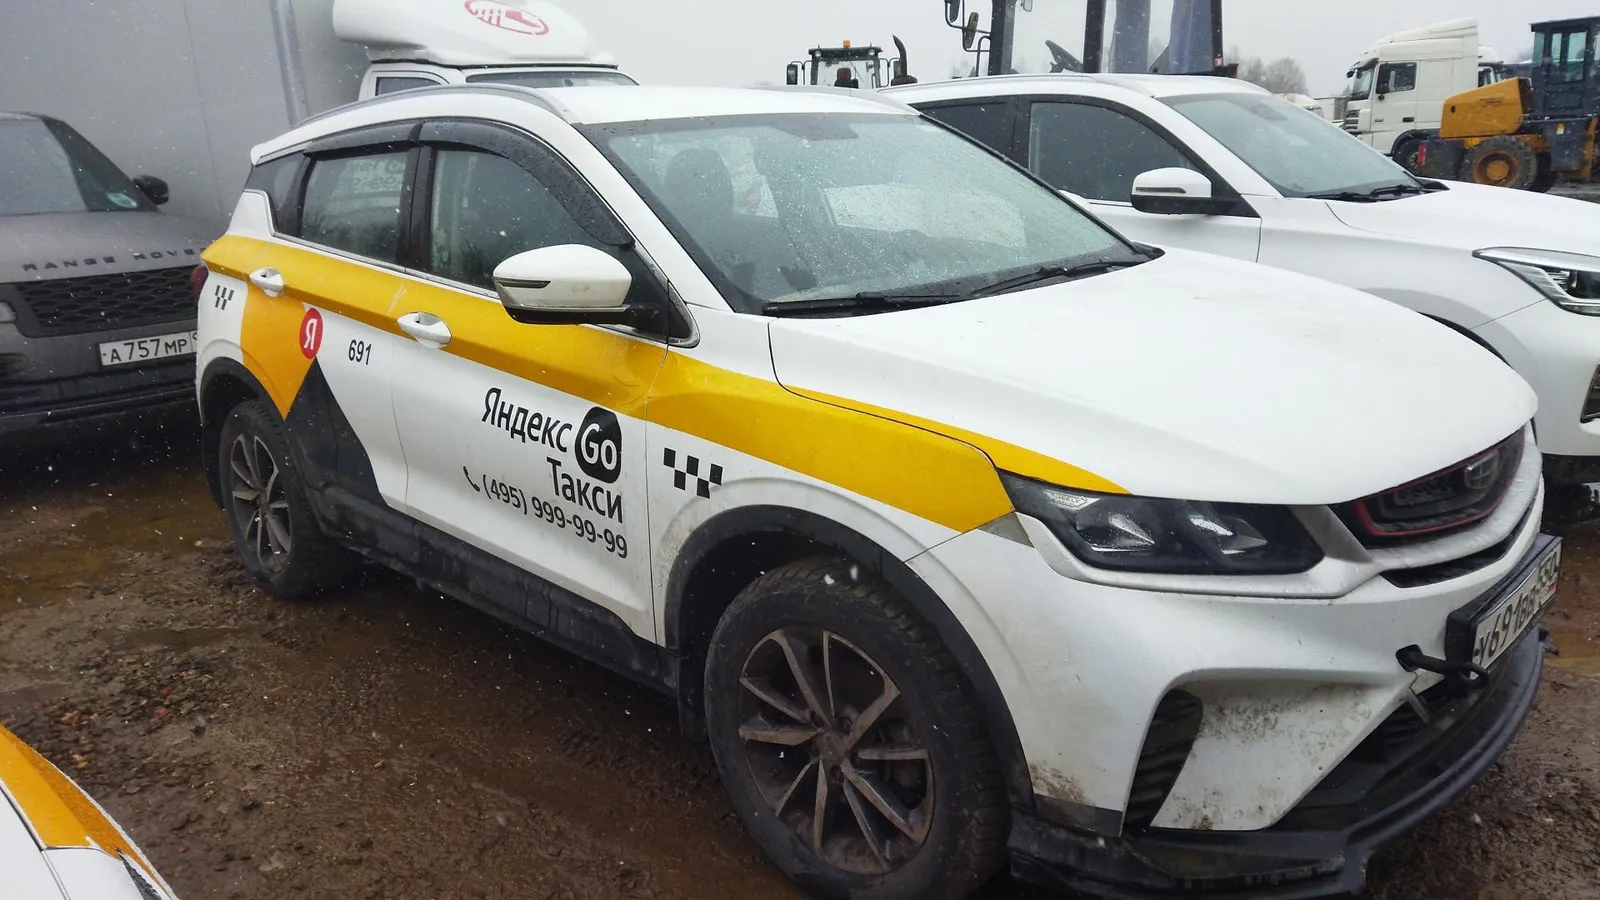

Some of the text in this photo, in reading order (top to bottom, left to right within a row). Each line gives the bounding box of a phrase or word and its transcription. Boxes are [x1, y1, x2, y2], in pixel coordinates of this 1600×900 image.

[23, 248, 203, 271] RANGE ROVE
[303, 318, 318, 350] Я
[348, 339, 372, 365] 691
[481, 387, 618, 471] Яндекс Go
[546, 456, 623, 524] Такси
[483, 474, 628, 559] (495) 999-99-99
